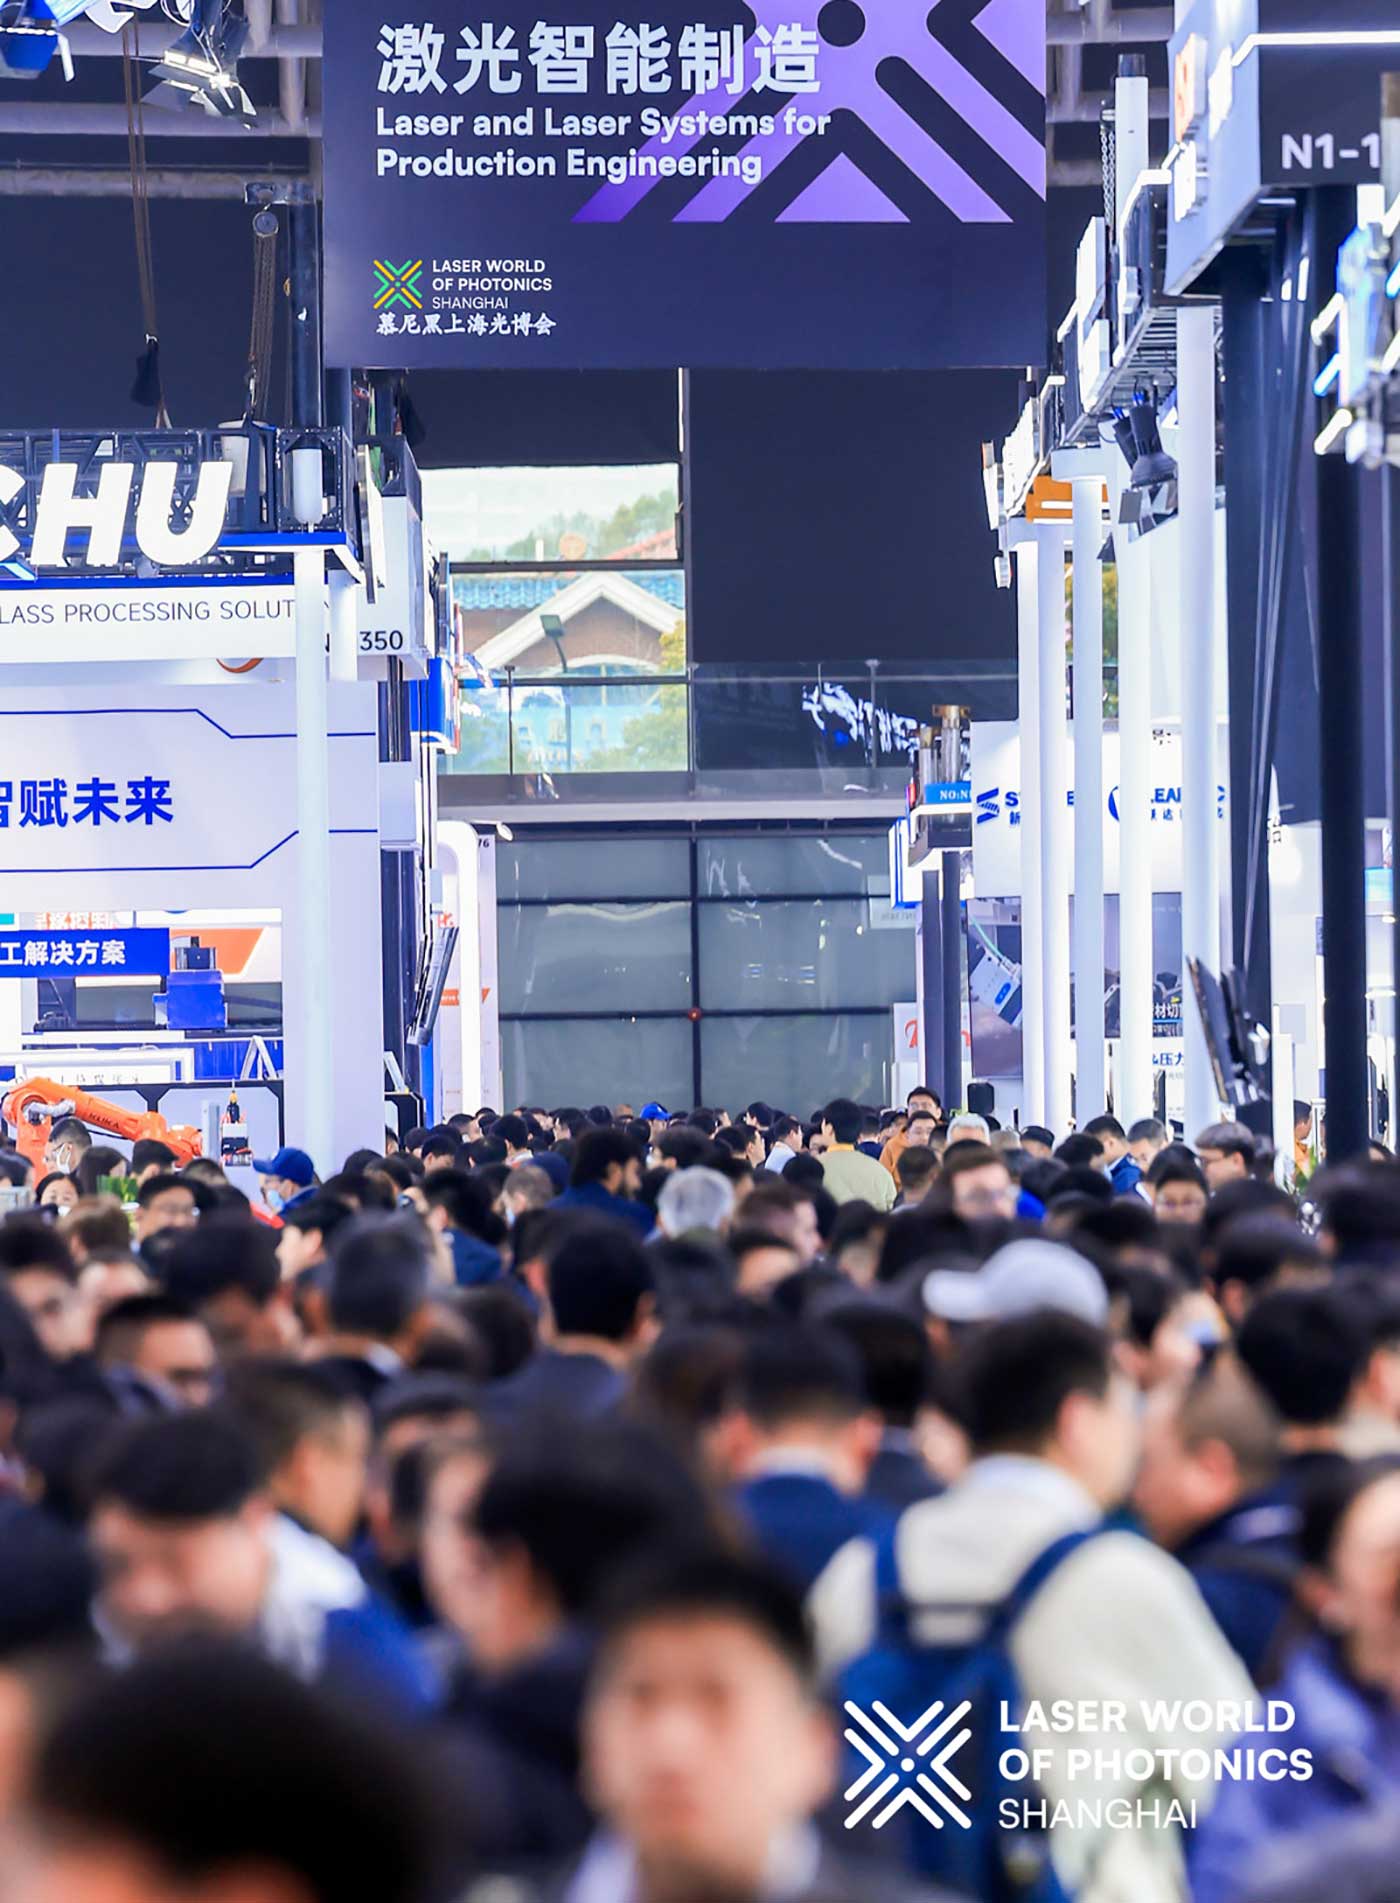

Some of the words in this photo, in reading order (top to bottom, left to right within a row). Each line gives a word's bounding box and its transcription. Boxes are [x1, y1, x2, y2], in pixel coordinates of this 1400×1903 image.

[376, 21, 821, 94] 激光智能制造
[377, 107, 464, 136] Laser
[473, 107, 534, 136] and
[545, 107, 632, 136] Laser
[640, 107, 775, 144] Systems
[784, 107, 832, 136] for
[377, 148, 557, 177] Production
[567, 148, 762, 185] Engineering
[432, 259, 482, 273] LASER
[485, 259, 546, 273] WORLD
[432, 278, 454, 291] OF
[458, 278, 553, 291] PHOTONICS
[432, 297, 509, 309] SHANGHAI
[376, 311, 557, 337] 慕尼黑上海光博会
[64, 600, 211, 623] PROCESSING
[0, 776, 174, 828] 赋未来
[0, 939, 126, 967] 工解决方案
